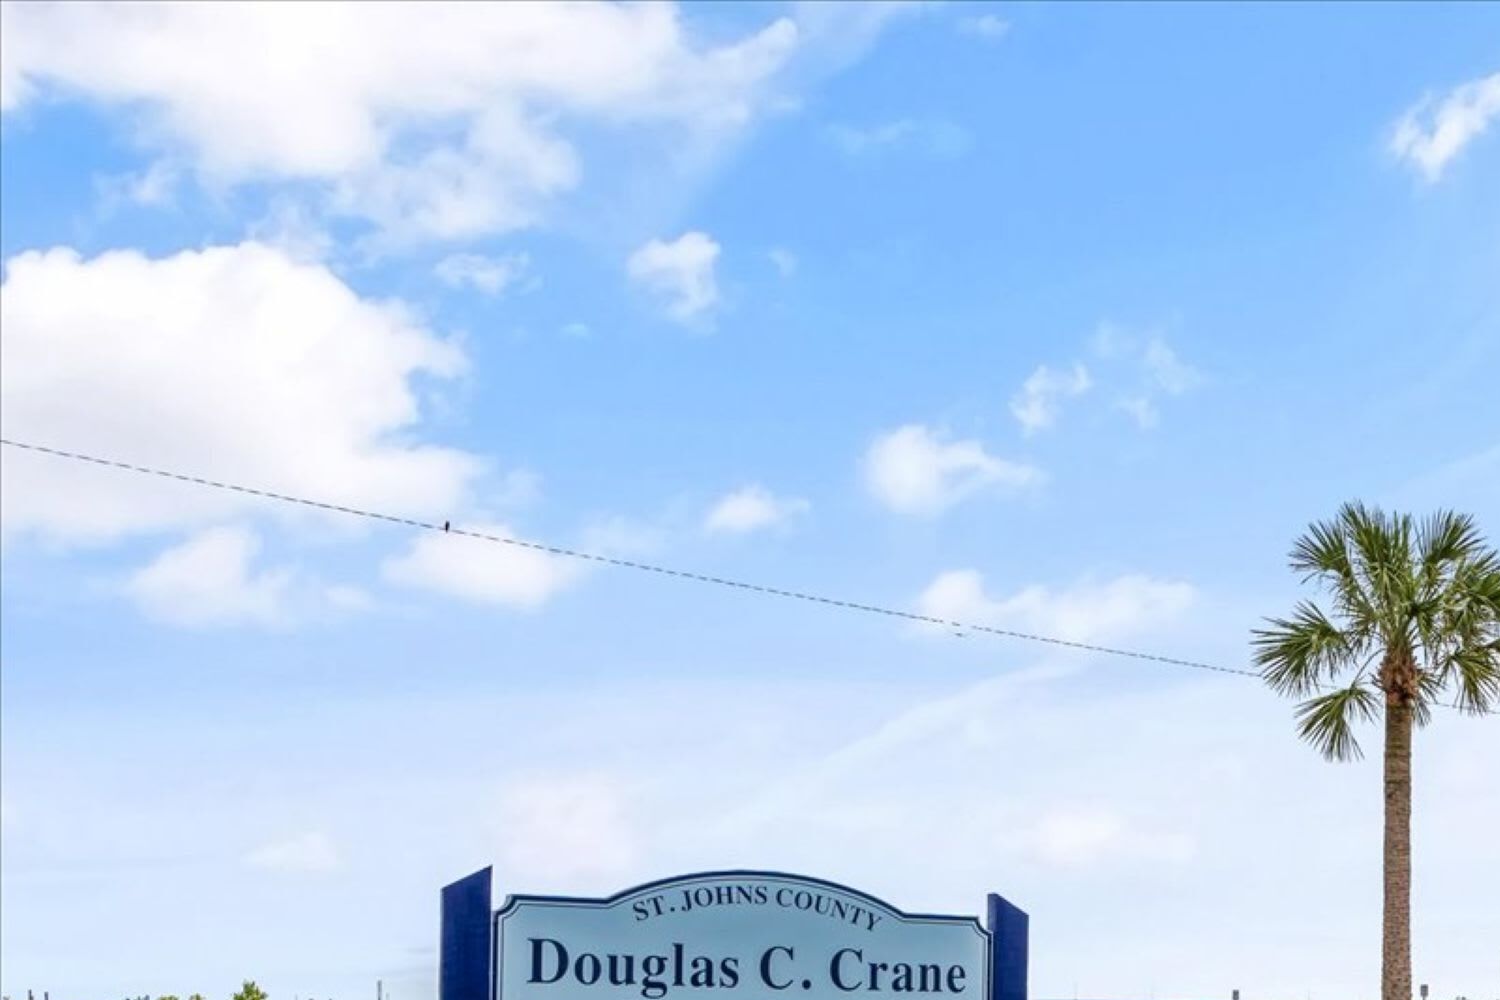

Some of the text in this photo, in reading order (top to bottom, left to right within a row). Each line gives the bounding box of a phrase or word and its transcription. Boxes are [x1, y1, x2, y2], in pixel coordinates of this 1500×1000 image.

[681, 885, 768, 912] JOHNS
[775, 888, 883, 932] COUNTY
[526, 938, 967, 998] Douglas C. Crane
